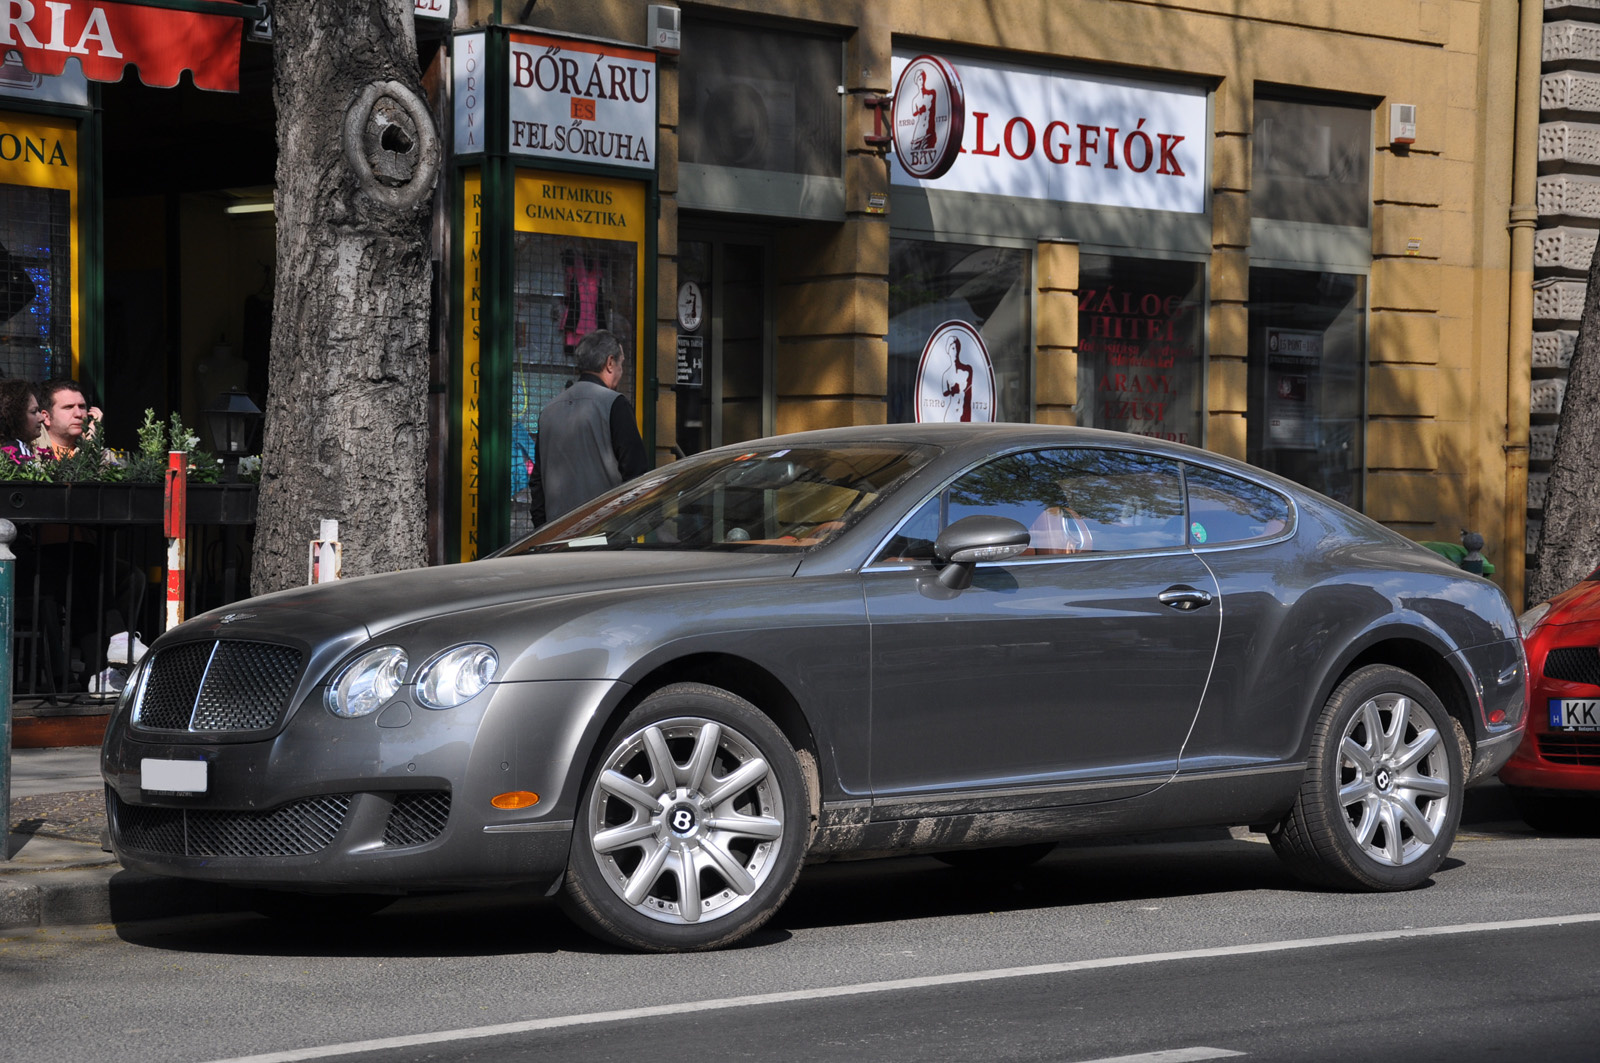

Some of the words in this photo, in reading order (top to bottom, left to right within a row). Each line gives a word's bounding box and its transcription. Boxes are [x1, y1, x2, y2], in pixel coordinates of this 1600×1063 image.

[0, 0, 123, 59] RIA
[466, 40, 476, 146] KORONA
[512, 45, 650, 104] BŐRÁRU
[573, 99, 594, 119] ÉS
[0, 133, 69, 168] ONA
[512, 120, 650, 163] FELSŐRUHA
[958, 112, 1186, 177] LOGFIÓK
[525, 204, 626, 228] GIMNASZTIKA
[542, 184, 612, 206] RITMIKUS
[470, 193, 481, 340] RITMIKUS
[1566, 702, 1597, 724] KK
